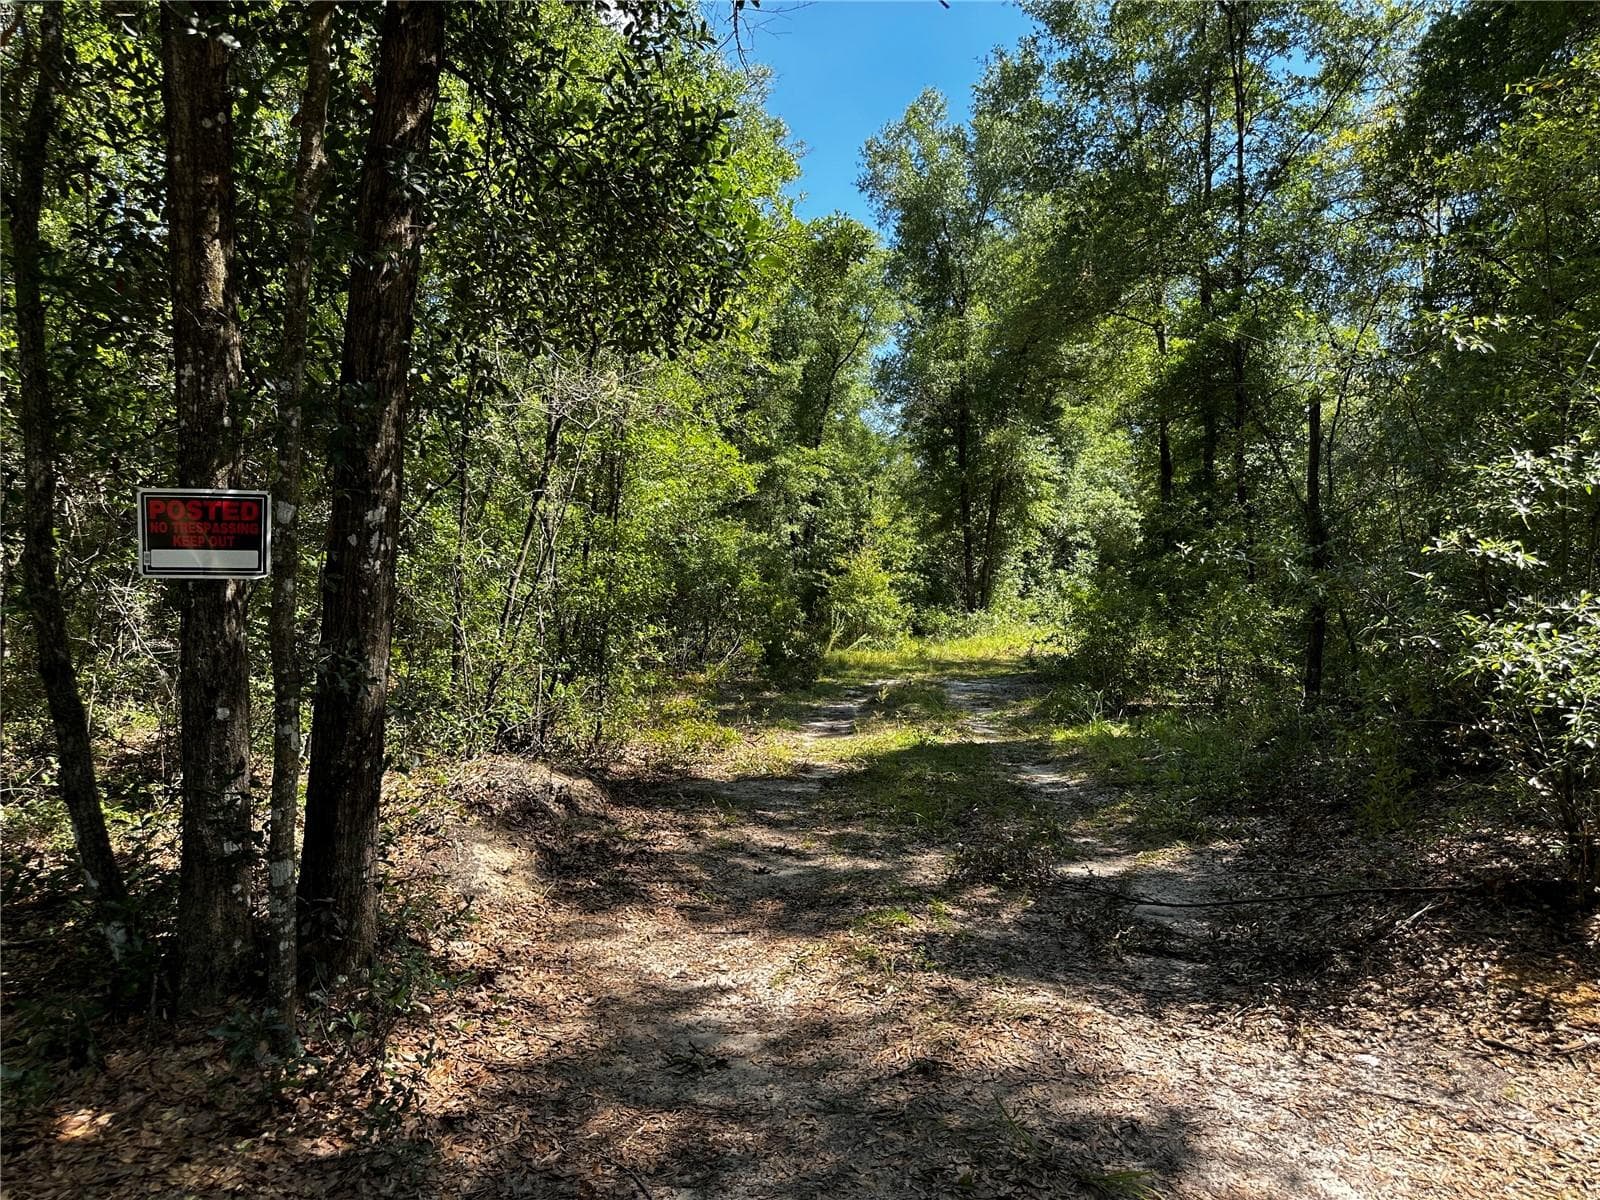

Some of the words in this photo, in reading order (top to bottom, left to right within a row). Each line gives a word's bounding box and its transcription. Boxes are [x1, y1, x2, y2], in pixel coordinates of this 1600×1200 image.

[149, 500, 259, 520] POSTED
[150, 521, 168, 534] NO
[173, 521, 258, 535] TRESPASSING
[172, 535, 205, 547] KEEP
[209, 535, 235, 547] OUT
